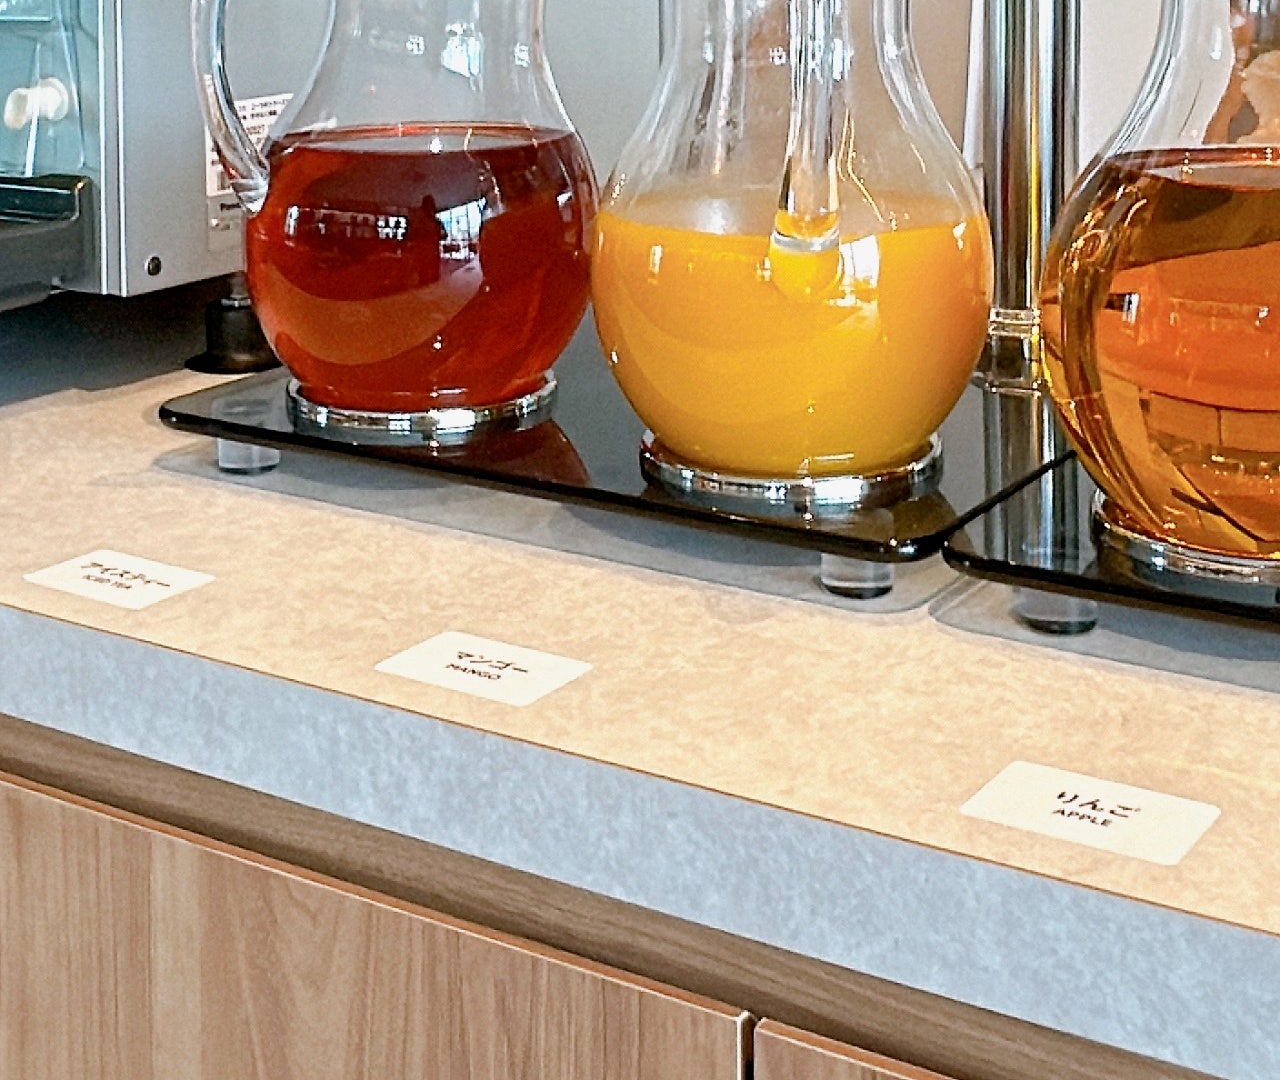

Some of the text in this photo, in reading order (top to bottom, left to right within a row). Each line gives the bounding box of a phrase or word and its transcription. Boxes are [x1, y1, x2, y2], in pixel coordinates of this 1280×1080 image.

[446, 663, 501, 680] MANGO
[457, 651, 529, 673] マンゴー
[1056, 791, 1142, 818] りんご
[1052, 808, 1113, 828] APPLE
